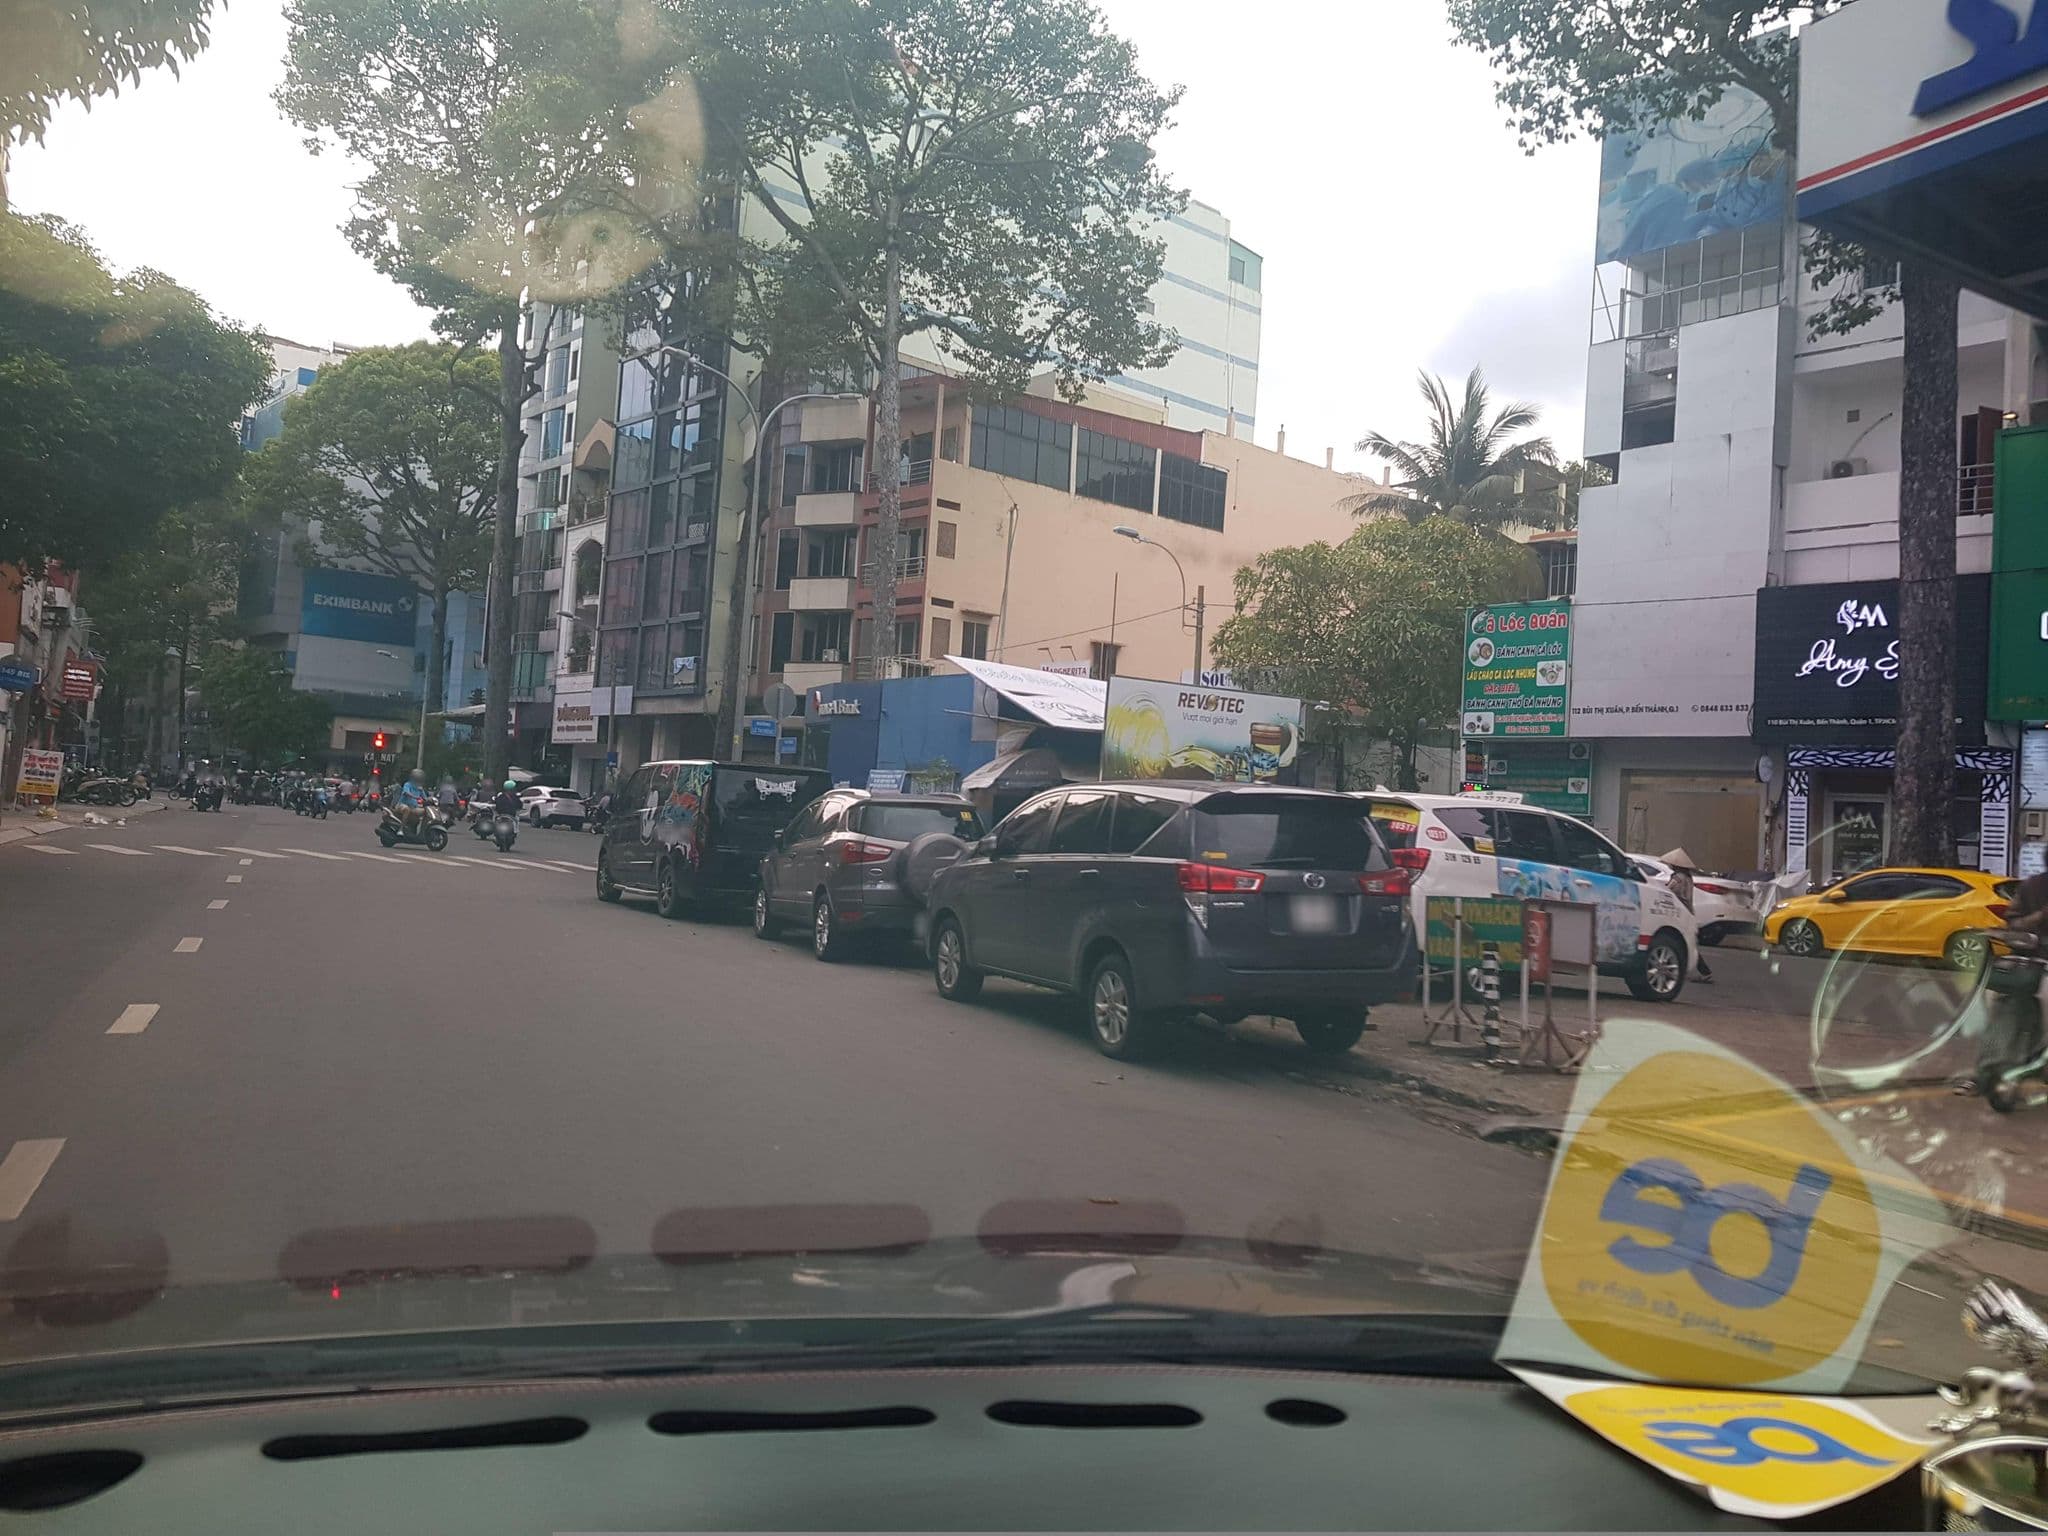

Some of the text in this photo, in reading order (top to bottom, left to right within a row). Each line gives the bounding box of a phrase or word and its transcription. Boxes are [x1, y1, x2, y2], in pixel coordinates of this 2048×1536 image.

[313, 593, 393, 615] EXIMBANK
[1517, 645, 1535, 658] CANH
[1795, 638, 1870, 688] Amy
[1642, 1415, 1898, 1467] be
